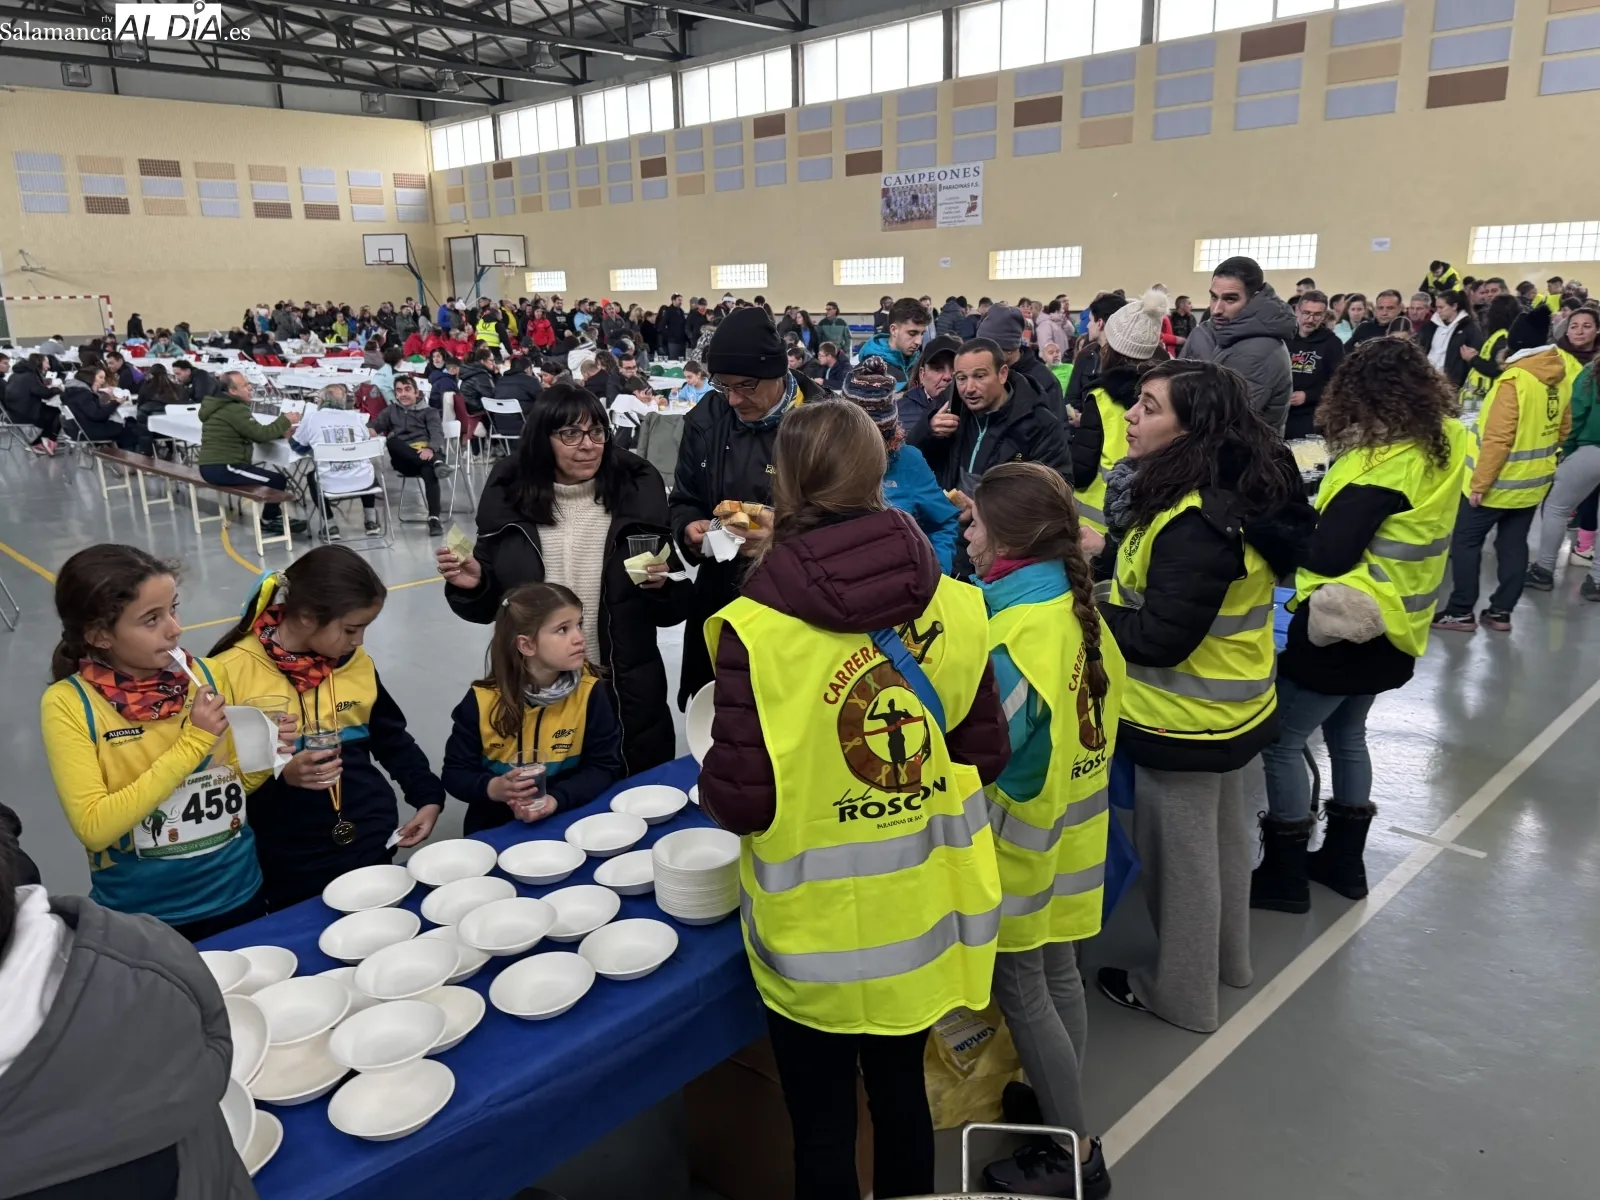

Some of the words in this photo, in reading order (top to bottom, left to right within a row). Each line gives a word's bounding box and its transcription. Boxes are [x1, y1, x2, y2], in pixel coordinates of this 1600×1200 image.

[883, 165, 980, 187] CAMPEONES
[942, 183, 970, 191] PARADINAS
[181, 782, 243, 825] 458
[876, 819, 906, 829] PARADINAS
